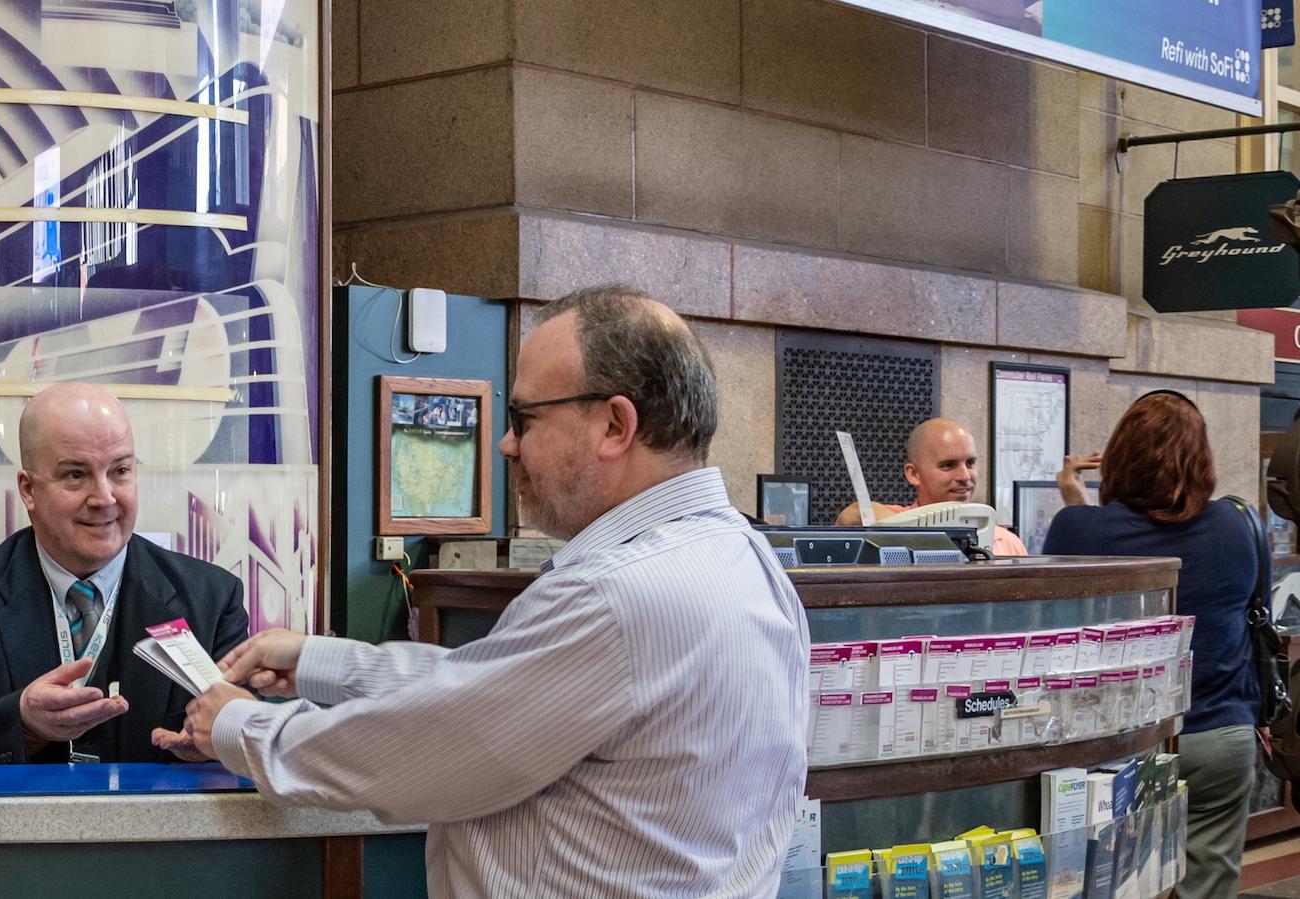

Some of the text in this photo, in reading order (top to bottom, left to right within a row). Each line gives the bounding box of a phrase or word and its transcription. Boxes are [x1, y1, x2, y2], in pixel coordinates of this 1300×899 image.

[1161, 37, 1234, 79] Refi with SoFi
[1159, 243, 1286, 265] Greyhound
[996, 369, 1025, 380] Commuter
[1026, 371, 1036, 381] Rail
[964, 696, 1011, 713] Schedules
